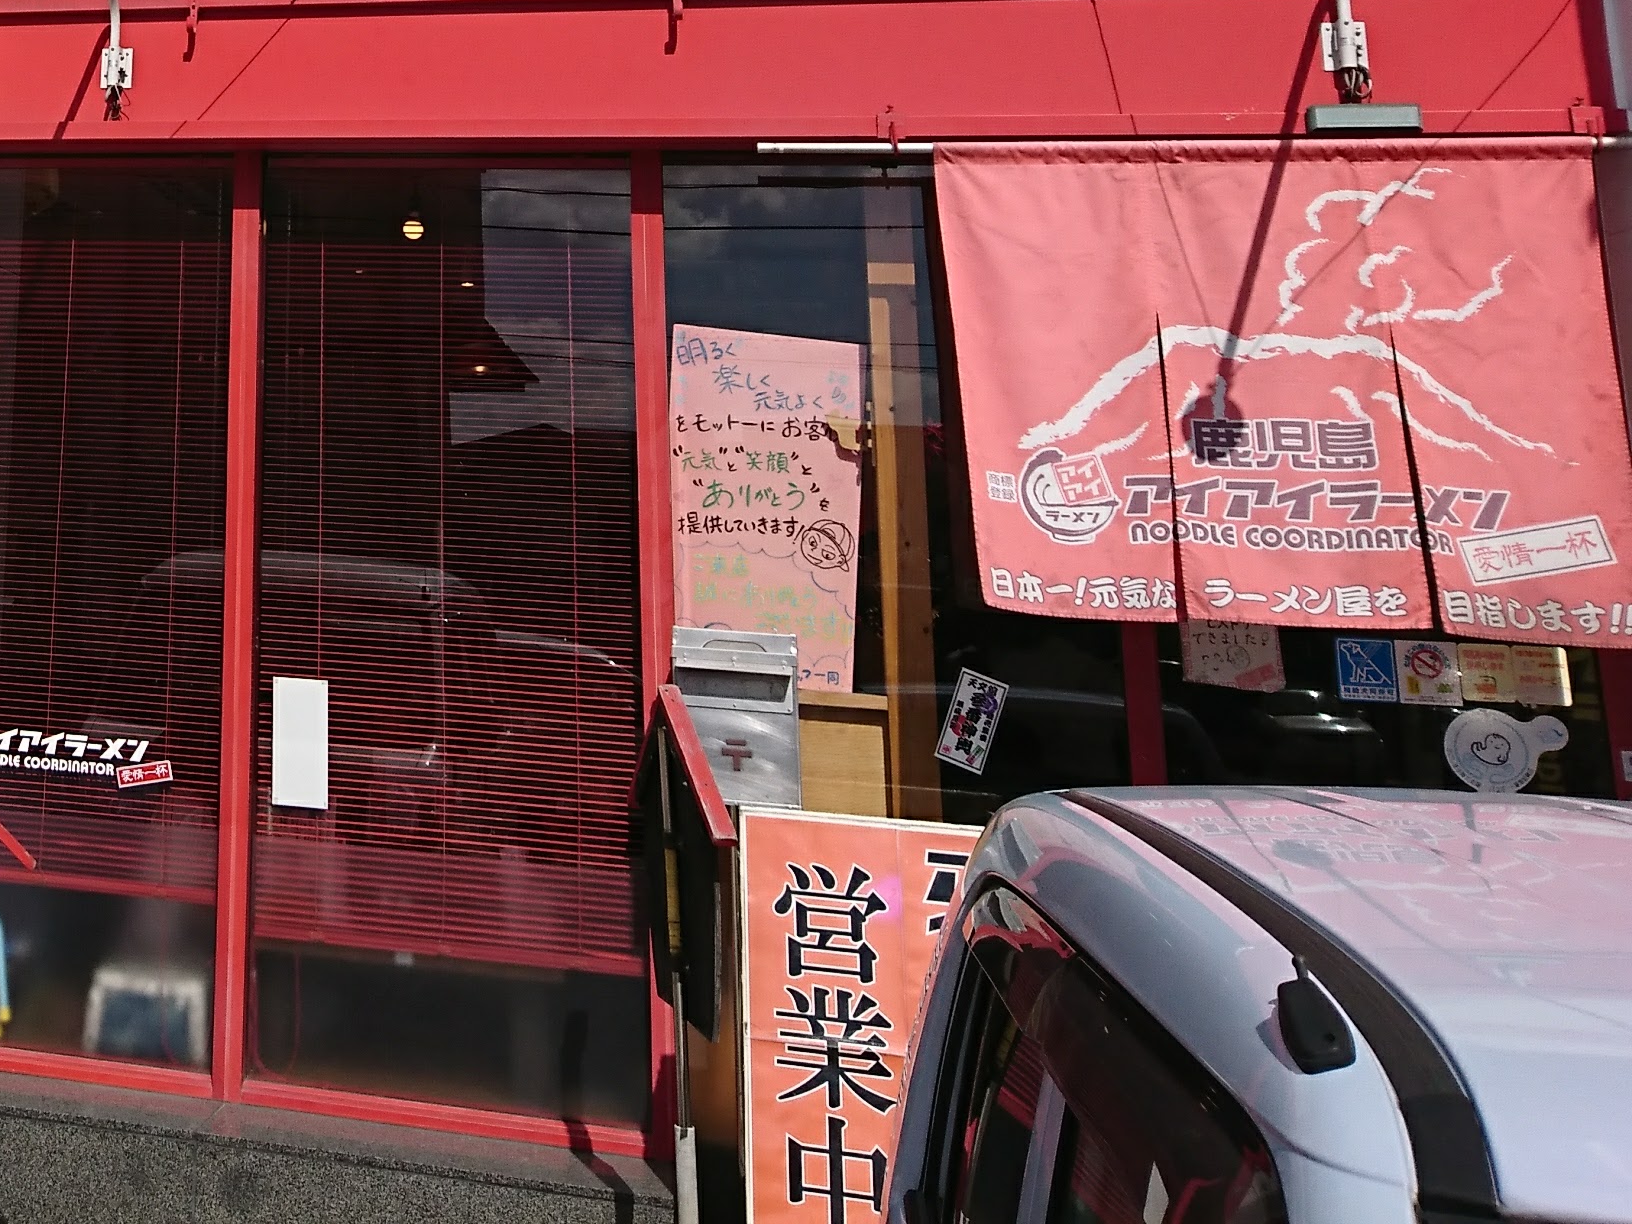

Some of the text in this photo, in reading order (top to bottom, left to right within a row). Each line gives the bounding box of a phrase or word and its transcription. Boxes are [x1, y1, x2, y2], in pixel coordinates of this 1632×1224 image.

[677, 337, 738, 366] 明るく
[712, 364, 772, 394] 楽しく
[753, 390, 825, 412] 元気よく
[675, 413, 825, 442] をモットーにお客
[1192, 419, 1378, 471] 鹿児島
[1045, 509, 1101, 524] ラーメン
[1124, 474, 1511, 533] アイアイラーメン
[1130, 520, 1455, 556] NOODLE COORDINATOR
[1473, 529, 1598, 574] 愛情一杯
[990, 566, 1177, 610] 日本一!元気な
[1204, 578, 1408, 617] ラーメン屋を
[23, 755, 115, 777] COORDINATOR
[120, 764, 169, 783] 愛情一杯
[773, 862, 898, 1224] 営業中
